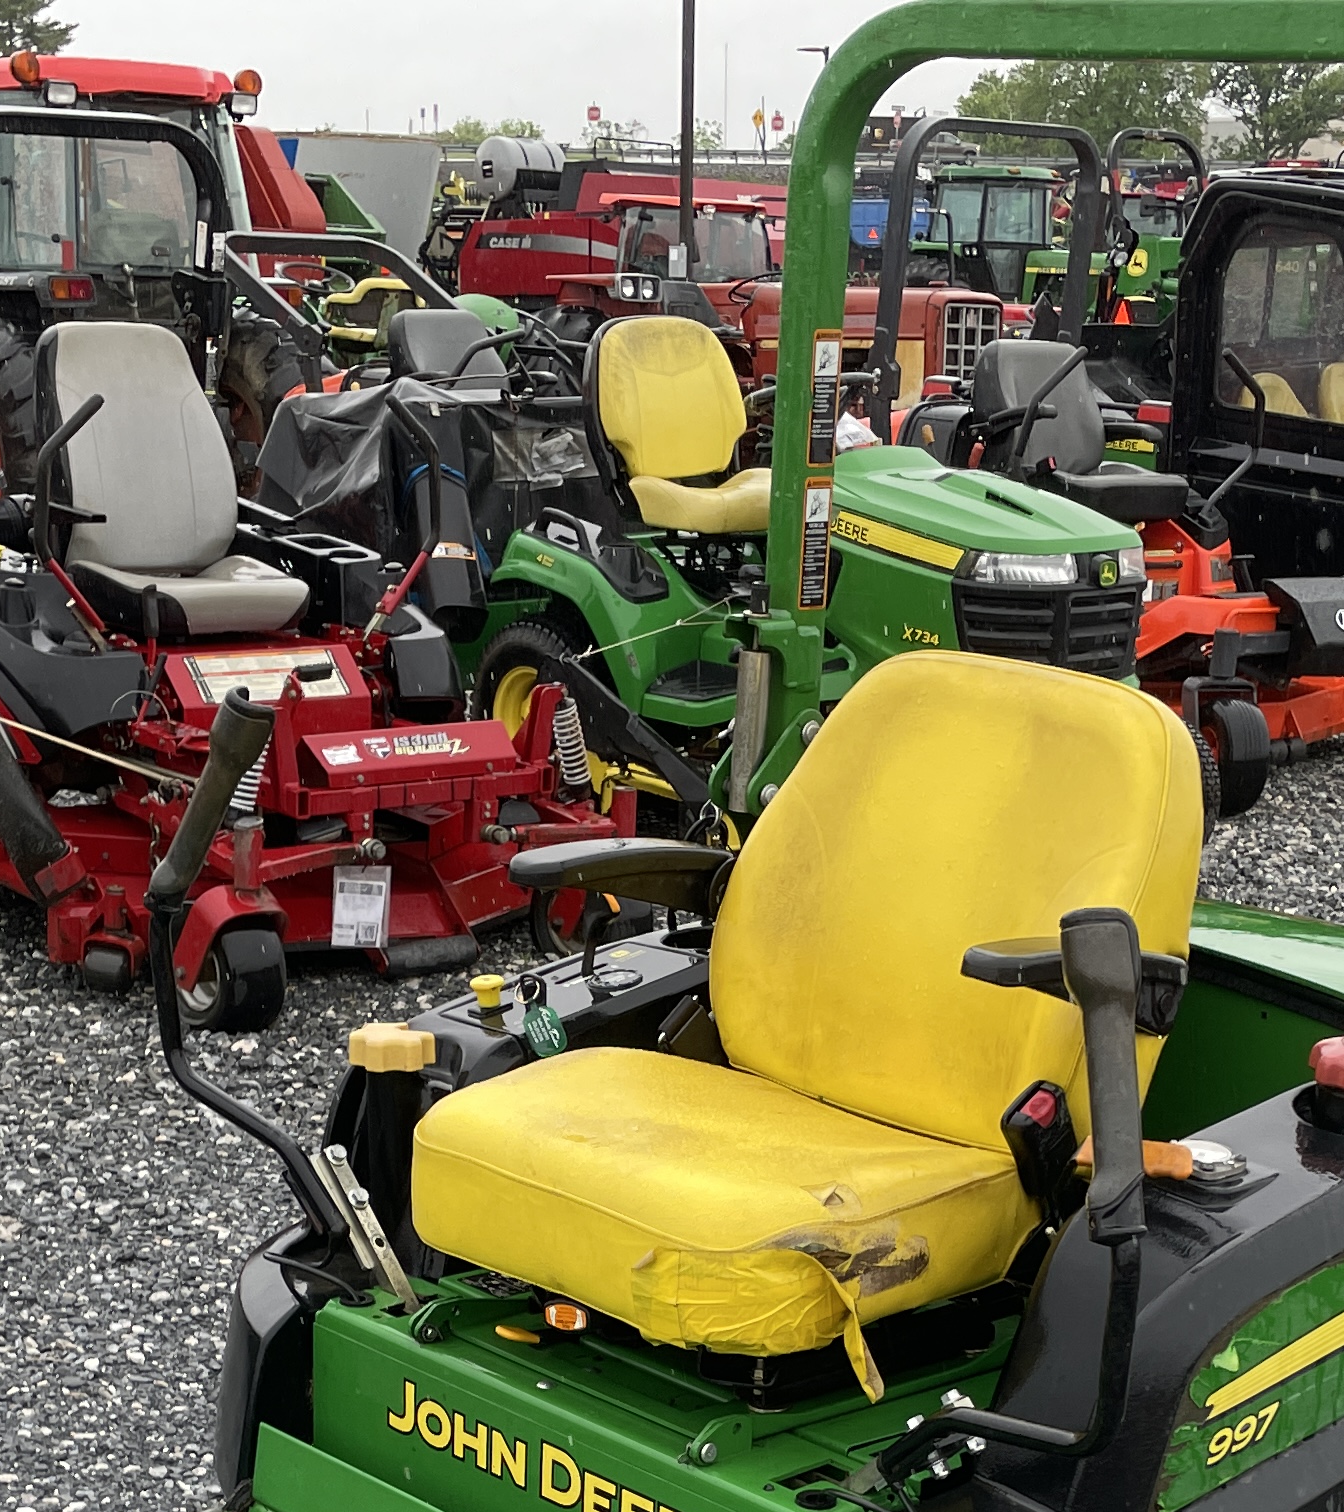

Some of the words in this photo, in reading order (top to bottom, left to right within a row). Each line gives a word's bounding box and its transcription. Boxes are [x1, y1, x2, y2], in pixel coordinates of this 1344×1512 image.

[489, 237, 520, 249] CASE
[902, 622, 941, 646] X734
[388, 1378, 527, 1490] JOHN
[1206, 1400, 1280, 1467] 997
